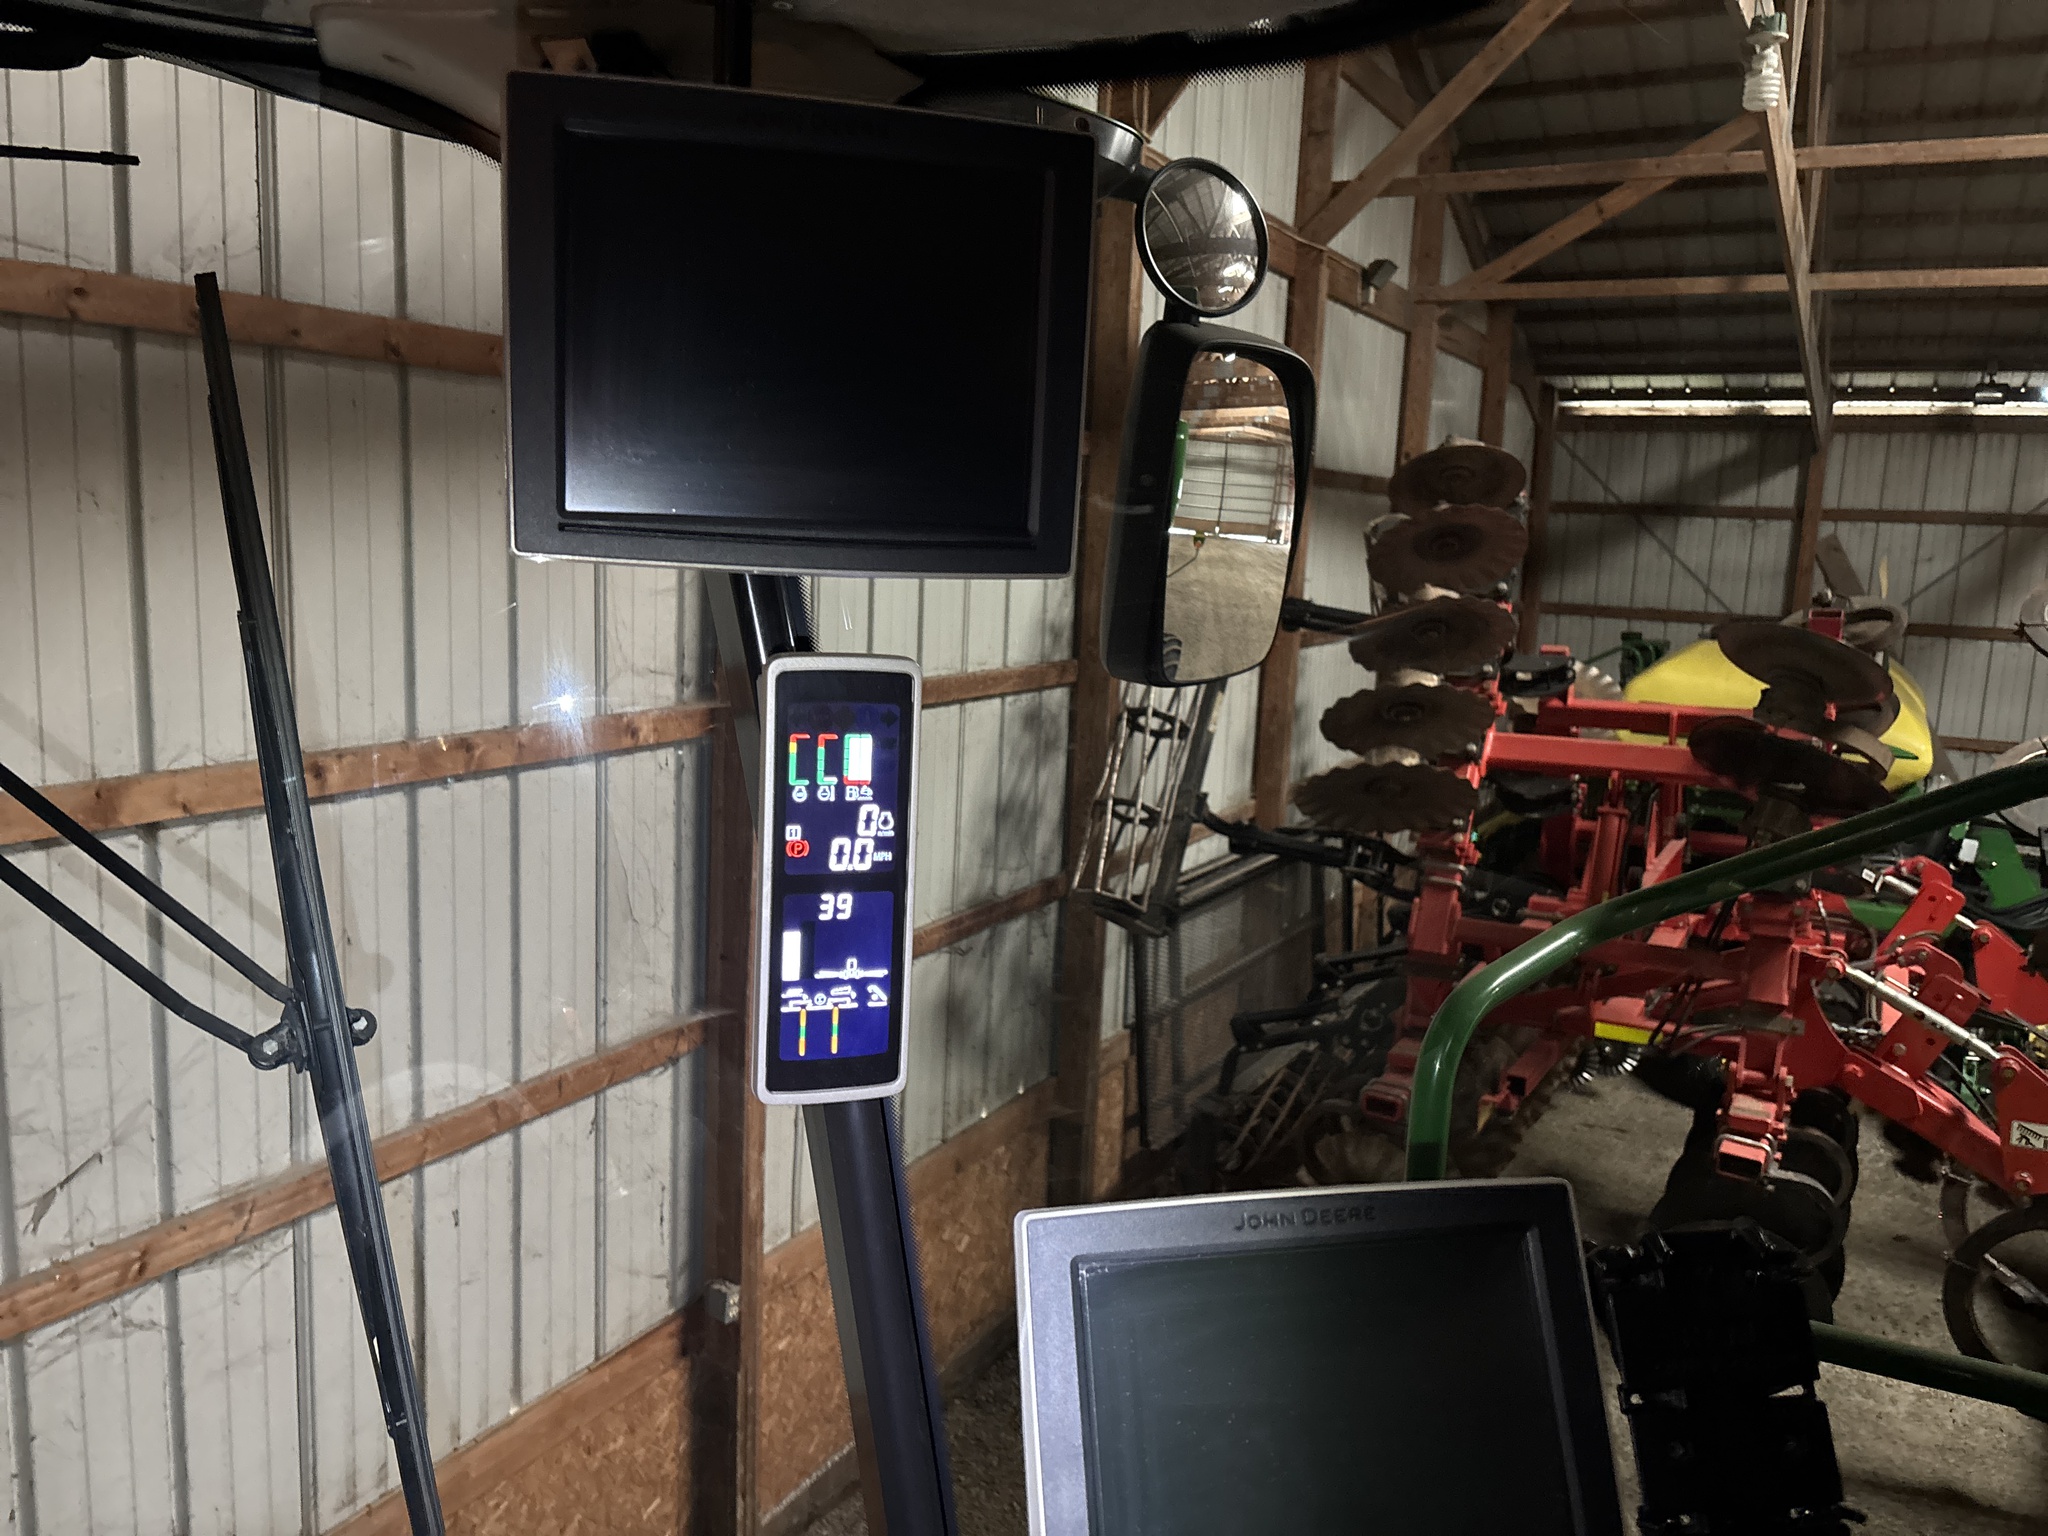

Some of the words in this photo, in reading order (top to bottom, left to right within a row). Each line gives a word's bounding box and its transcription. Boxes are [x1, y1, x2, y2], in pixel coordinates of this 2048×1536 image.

[857, 804, 879, 837] 0
[829, 838, 875, 871] 0.0
[873, 852, 892, 861] MPH
[818, 893, 853, 920] 39
[1233, 1212, 1297, 1231] JOHN
[1300, 1206, 1376, 1225] DEERE
